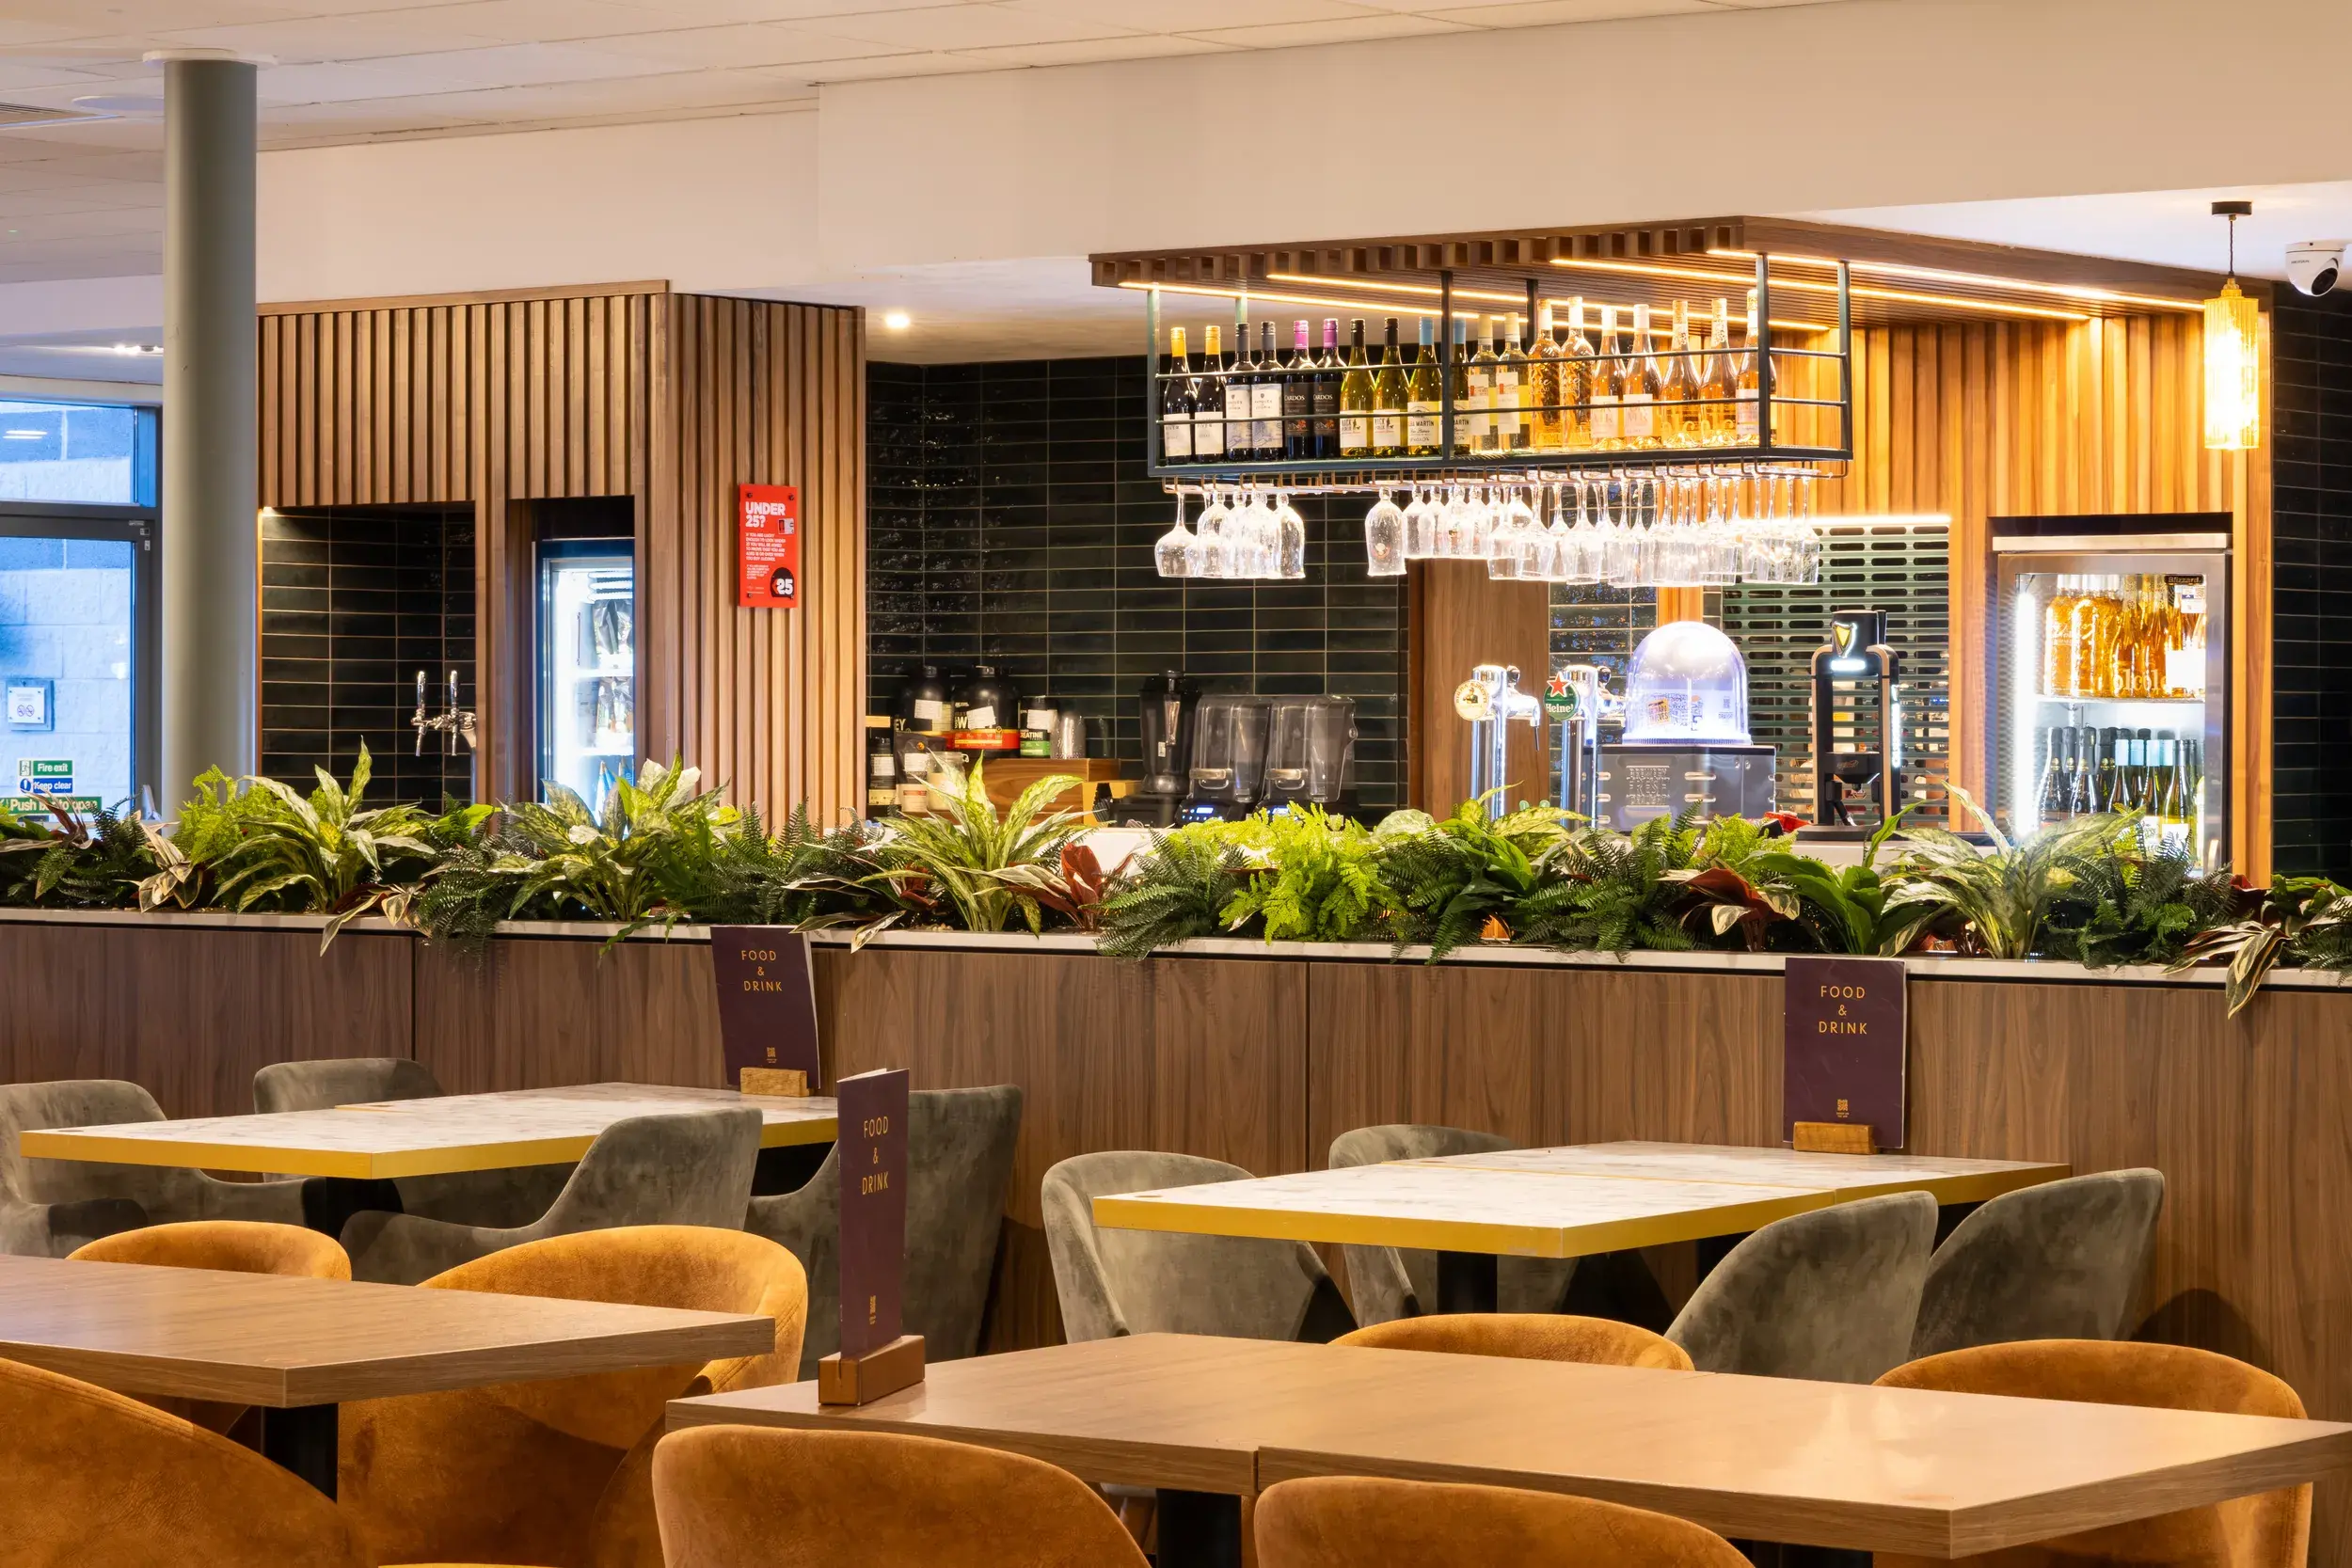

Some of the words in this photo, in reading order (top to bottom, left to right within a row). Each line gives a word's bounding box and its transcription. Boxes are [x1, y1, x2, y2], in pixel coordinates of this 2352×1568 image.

[745, 501, 786, 515] UNDER
[745, 515, 766, 528] 25?
[776, 578, 793, 594] 25
[895, 719, 906, 731] EY
[38, 763, 53, 771] Fire
[54, 763, 68, 771] exit
[34, 781, 53, 791] Keep
[54, 781, 72, 790] clear
[10, 799, 36, 811] Push
[61, 800, 69, 810] to
[741, 950, 777, 961] FOOD
[757, 966, 765, 976] &
[743, 980, 783, 991] DRINK
[1820, 985, 1866, 999] FOOD
[1837, 1005, 1847, 1016] &
[1819, 1021, 1867, 1035] DRINK
[864, 1116, 889, 1138] FOOD
[873, 1147, 880, 1164] &
[862, 1171, 889, 1196] DRINK
